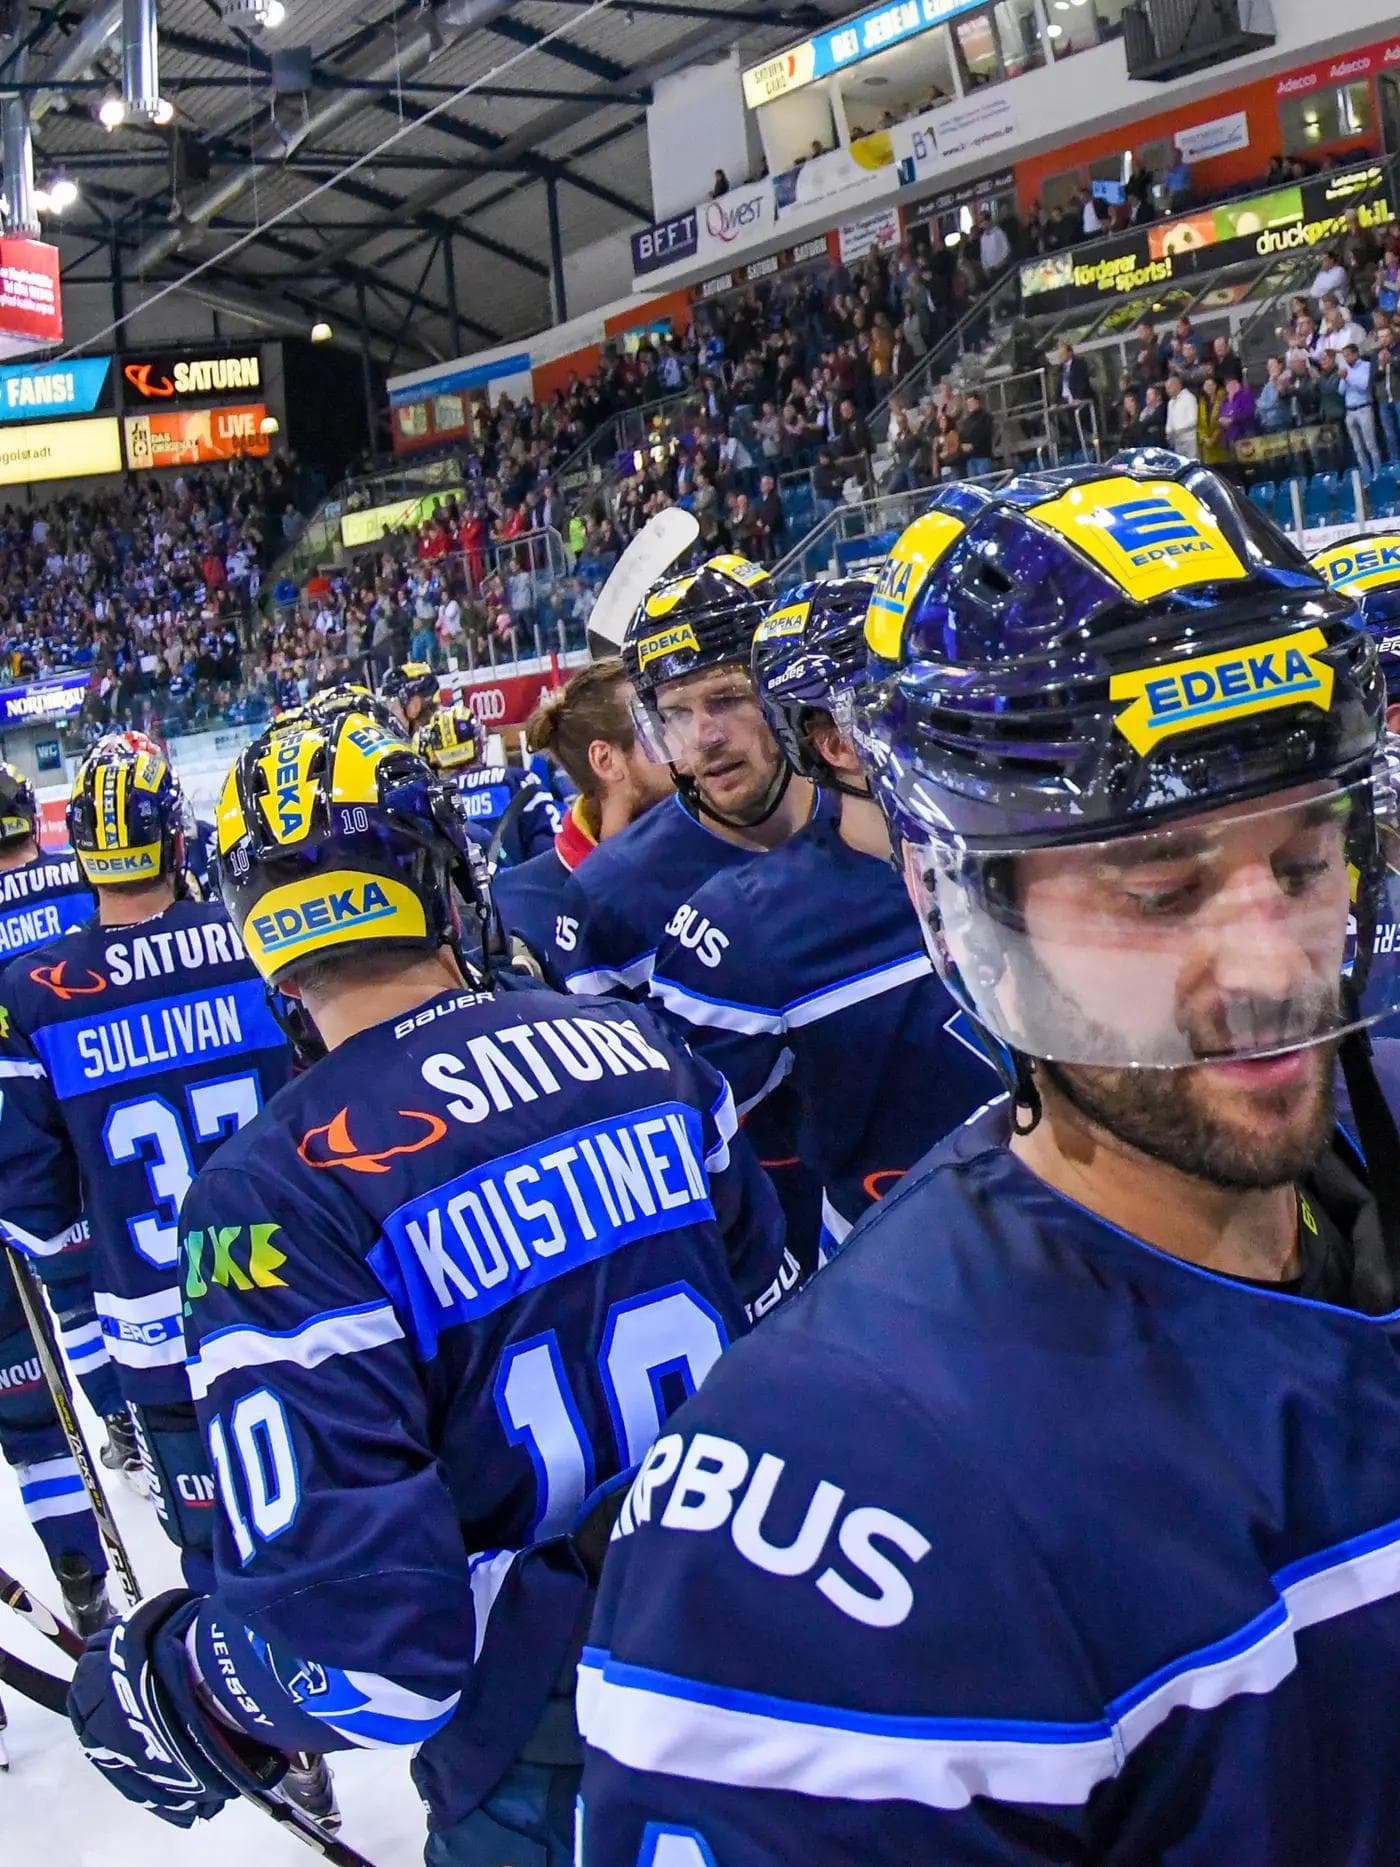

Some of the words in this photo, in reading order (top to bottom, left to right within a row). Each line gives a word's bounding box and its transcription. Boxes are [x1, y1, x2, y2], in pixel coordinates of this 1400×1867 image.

[1277, 74, 1318, 94] Adecco
[1330, 57, 1371, 77] Adecco
[638, 213, 694, 259] BFFT
[1115, 256, 1173, 293] sports!
[7, 373, 75, 408] FANS!
[173, 357, 259, 392] SATURN
[218, 413, 256, 438] LIVE
[1130, 540, 1216, 568] EDEKA
[640, 628, 693, 656] EDEKA
[1146, 647, 1313, 717] EDEKA
[37, 743, 58, 759] WC
[276, 734, 304, 839] EDEKA
[340, 806, 370, 836] 10
[86, 853, 153, 874] EDEKA
[230, 847, 251, 878] 10
[251, 880, 391, 946] EDEKA
[394, 990, 496, 1040] BAUER
[76, 994, 243, 1079] SULLIVAN
[119, 1322, 169, 1346] ERC
[208, 1384, 301, 1567] 10
[211, 1622, 275, 1728] JERSEY
